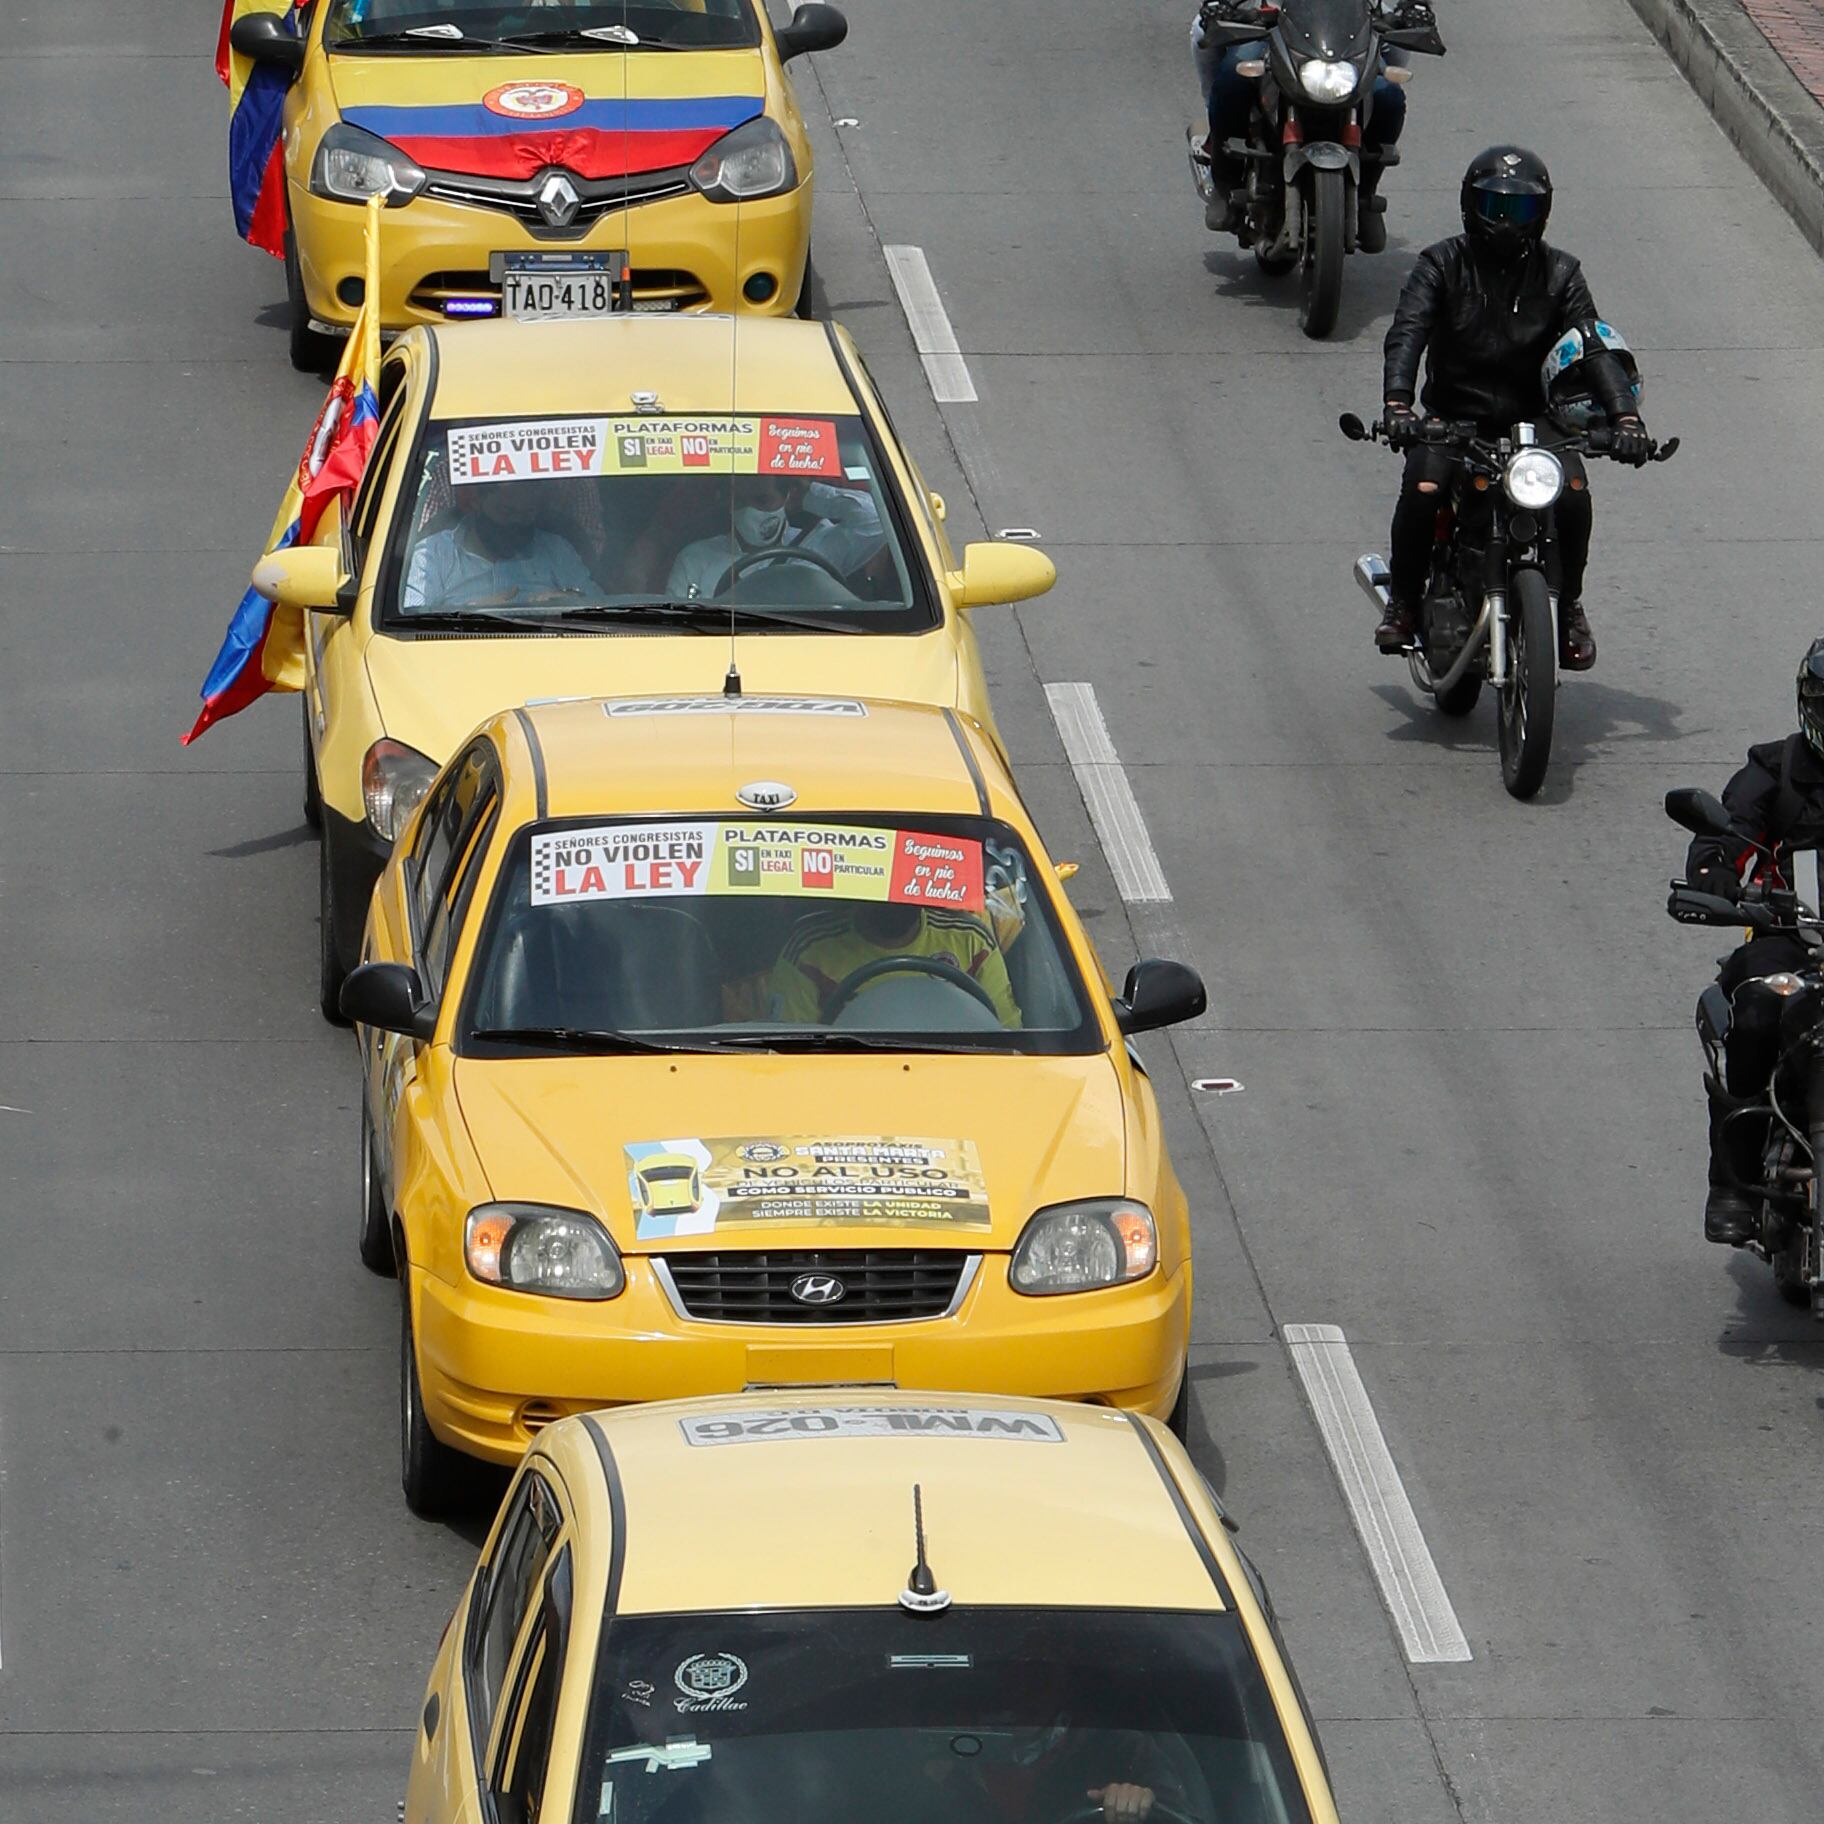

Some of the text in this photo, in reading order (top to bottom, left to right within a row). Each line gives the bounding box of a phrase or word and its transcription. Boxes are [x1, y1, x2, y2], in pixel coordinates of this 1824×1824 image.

[561, 283, 606, 311] 418
[468, 425, 596, 442] SEÑORES CONGRESISTAS
[614, 422, 753, 434] PLATAFORMAS
[469, 434, 597, 456] NO VIOLEN
[623, 439, 641, 456] SI
[682, 437, 707, 456] NO
[646, 446, 676, 456] LEGAL
[470, 449, 597, 478] LA LEY
[753, 792, 780, 805] TAXI
[555, 830, 704, 850] SEÑORES CONGRESISTAS
[725, 829, 887, 850] PLATAFORMAS
[555, 842, 704, 868] NO VIOLEN
[904, 838, 965, 863] Seguimos
[735, 849, 845, 874] SI EN TAXI NO EN
[761, 859, 885, 877] LEGAL PARTICULAR
[555, 860, 704, 896] LA LEY
[915, 864, 955, 881] en pie
[903, 881, 968, 902] de lucha!
[794, 1146, 946, 1159] SANTA MARTA
[822, 1156, 924, 1165] PRESENTES
[742, 1166, 949, 1180] NO AL USO
[736, 1179, 764, 1188] DE
[859, 1179, 959, 1188] PARTICULAR
[736, 1186, 958, 1197] COMO SERVICIO PUBLICO
[751, 1208, 954, 1220] SIEMPRE EXISTE LA VICTORIA
[761, 1201, 813, 1210] DONDE
[815, 1200, 860, 1209] EXISTE
[884, 1201, 942, 1210] UNIDAD
[694, 1415, 839, 1440] 026
[673, 1696, 749, 1714] Cadillac
